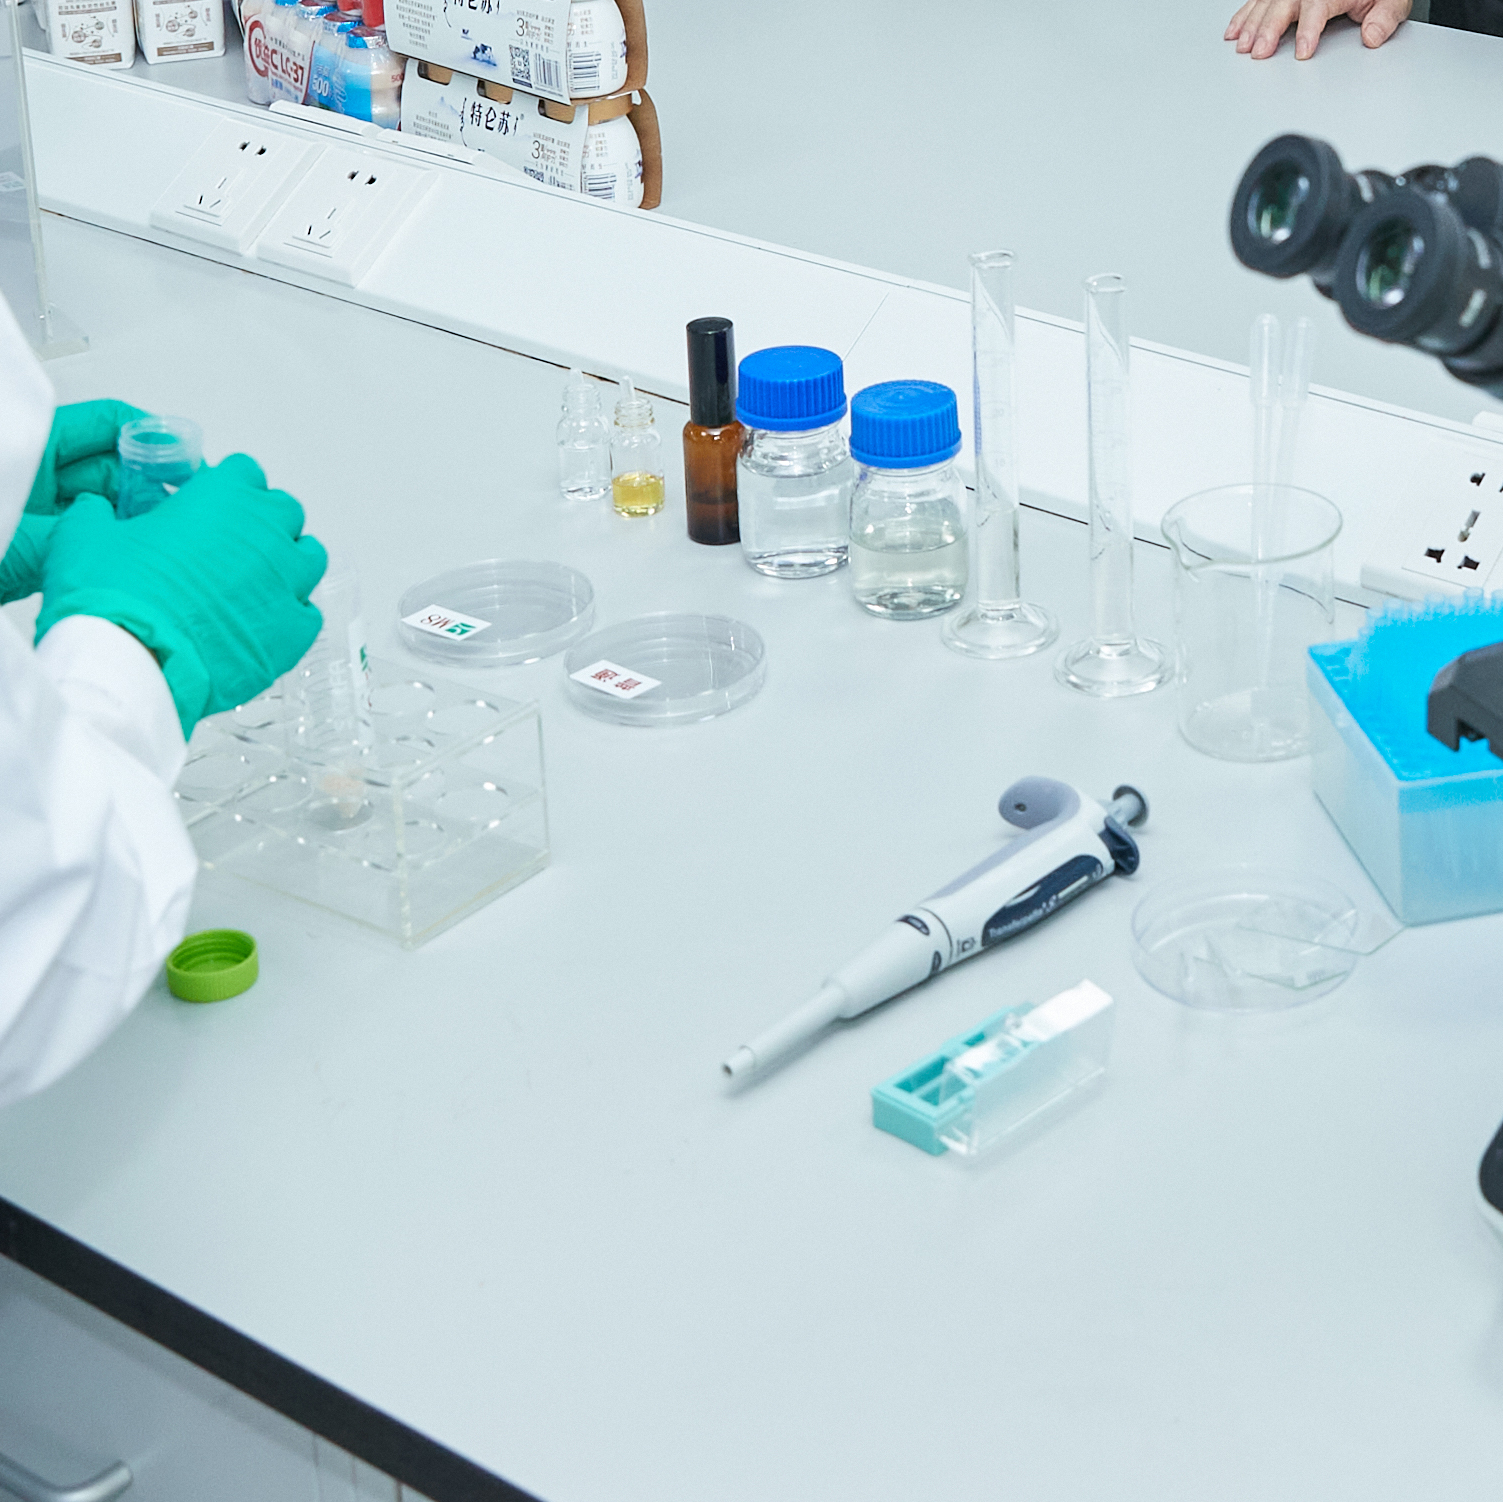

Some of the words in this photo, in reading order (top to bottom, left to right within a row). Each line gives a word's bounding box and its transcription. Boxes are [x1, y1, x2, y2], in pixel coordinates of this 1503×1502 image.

[311, 74, 330, 97] 500
[470, 101, 511, 136] 特仑苏
